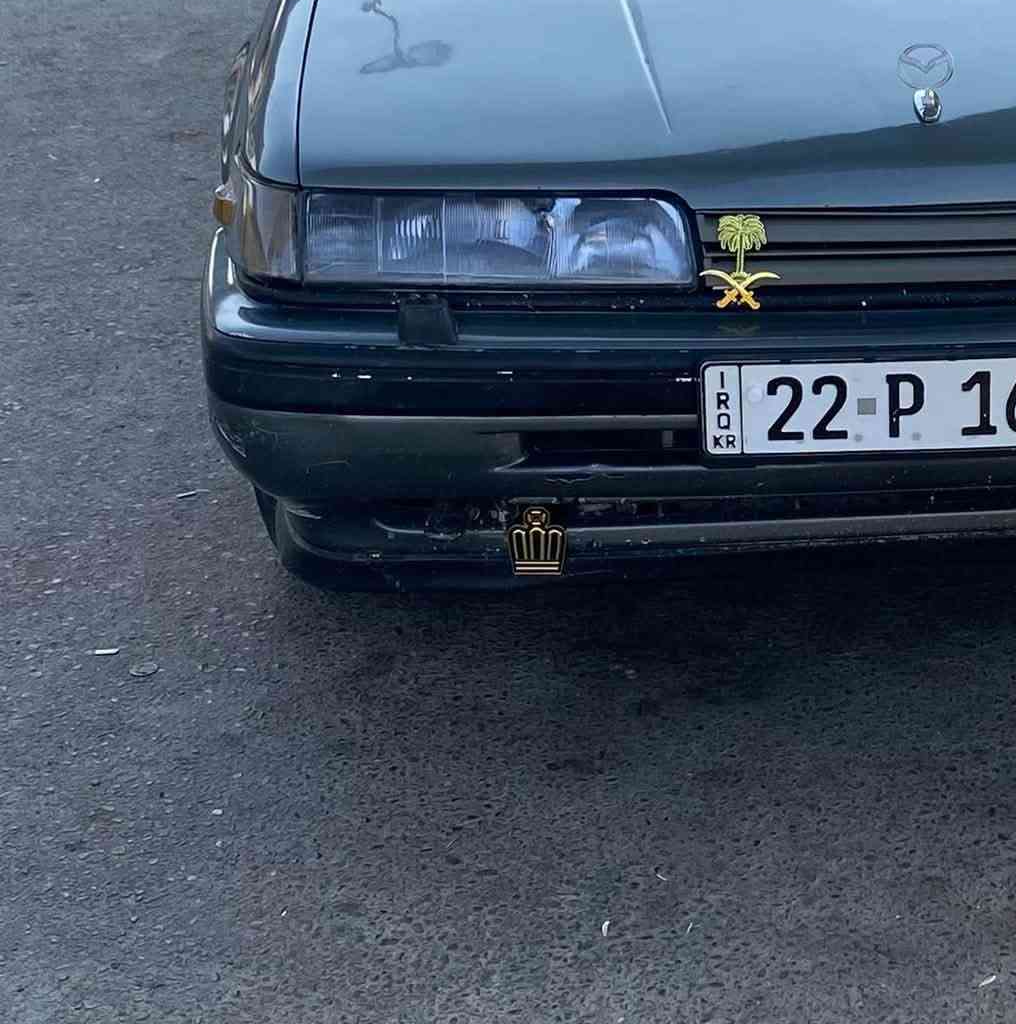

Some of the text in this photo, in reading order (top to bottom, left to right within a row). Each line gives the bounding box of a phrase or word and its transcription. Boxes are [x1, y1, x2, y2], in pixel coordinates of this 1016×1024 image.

[766, 375, 848, 442] 22
[885, 373, 925, 439] P
[712, 434, 736, 449] KR
